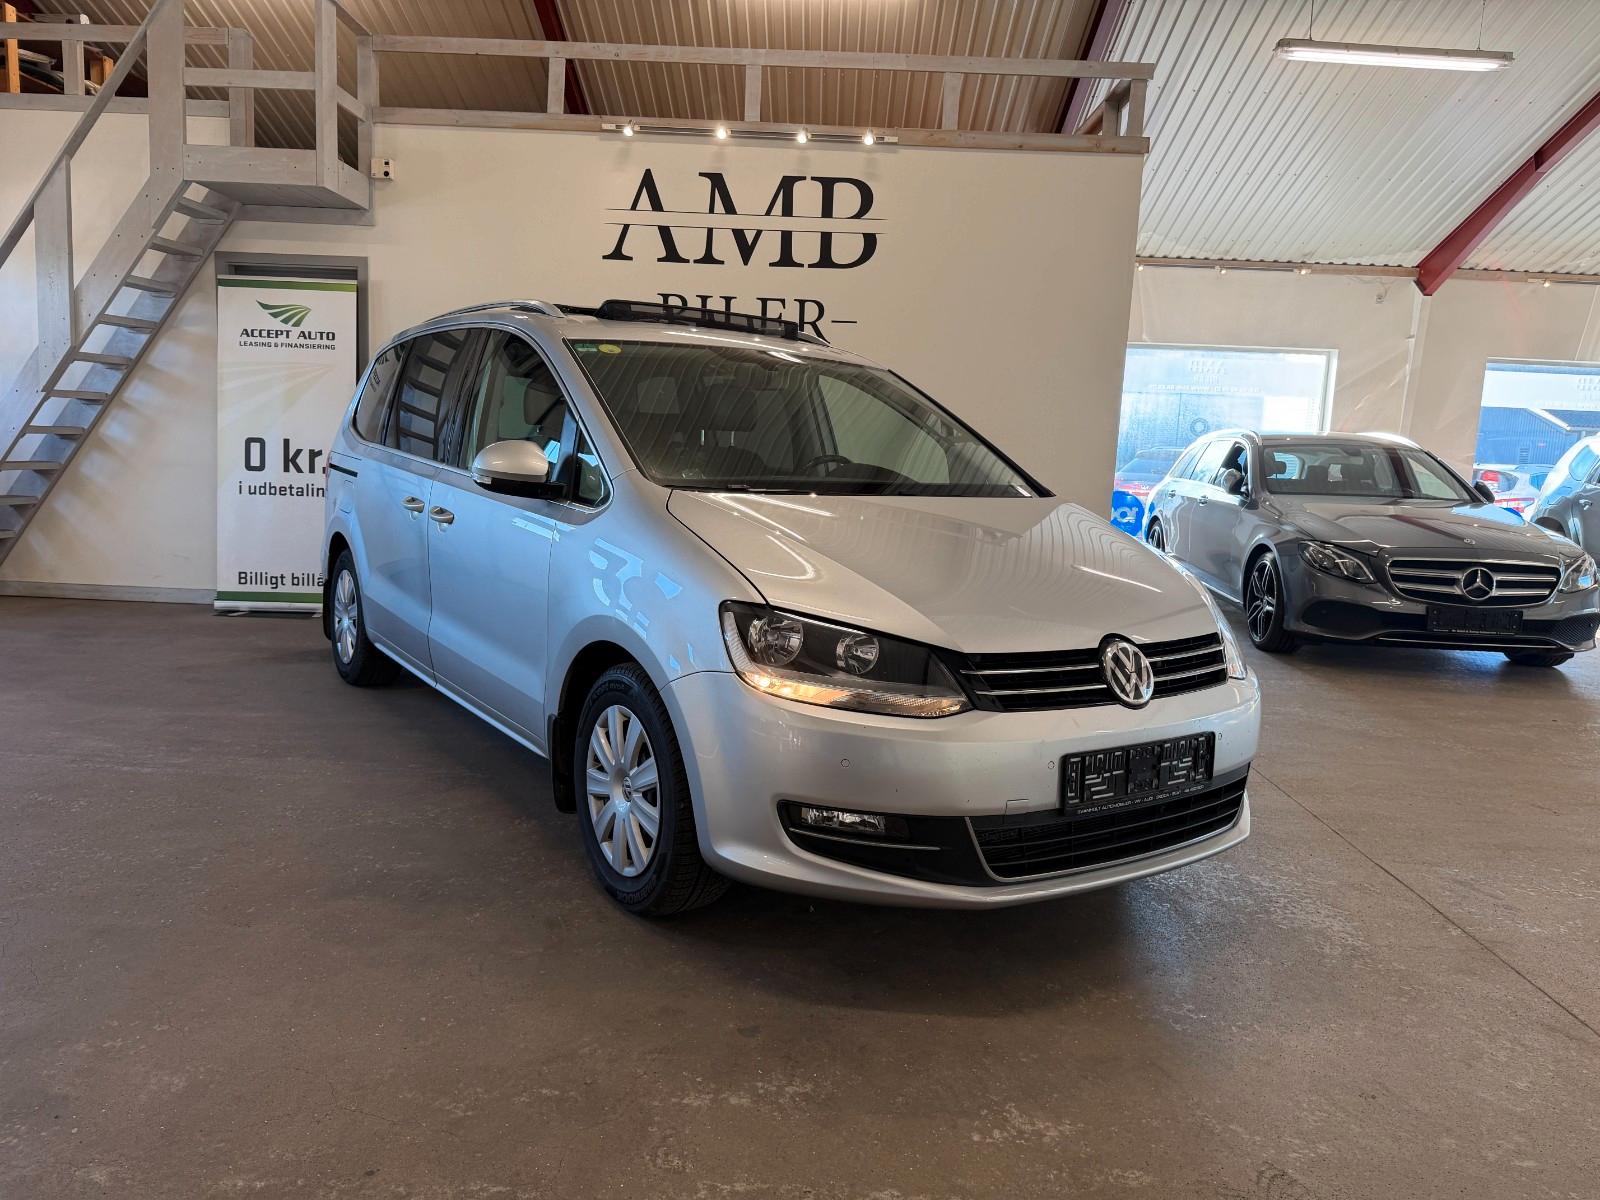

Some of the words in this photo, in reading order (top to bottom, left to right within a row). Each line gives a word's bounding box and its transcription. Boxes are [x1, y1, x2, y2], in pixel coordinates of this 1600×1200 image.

[602, 168, 878, 269] AMB
[239, 328, 292, 339] ACCEPT
[297, 330, 336, 341] AUTO
[239, 340, 272, 348] LEASING
[280, 342, 336, 351] FINANSIERING
[238, 480, 243, 495] i
[248, 481, 326, 498] udbetalin
[238, 571, 287, 589] Billigt
[291, 572, 325, 587] billå
